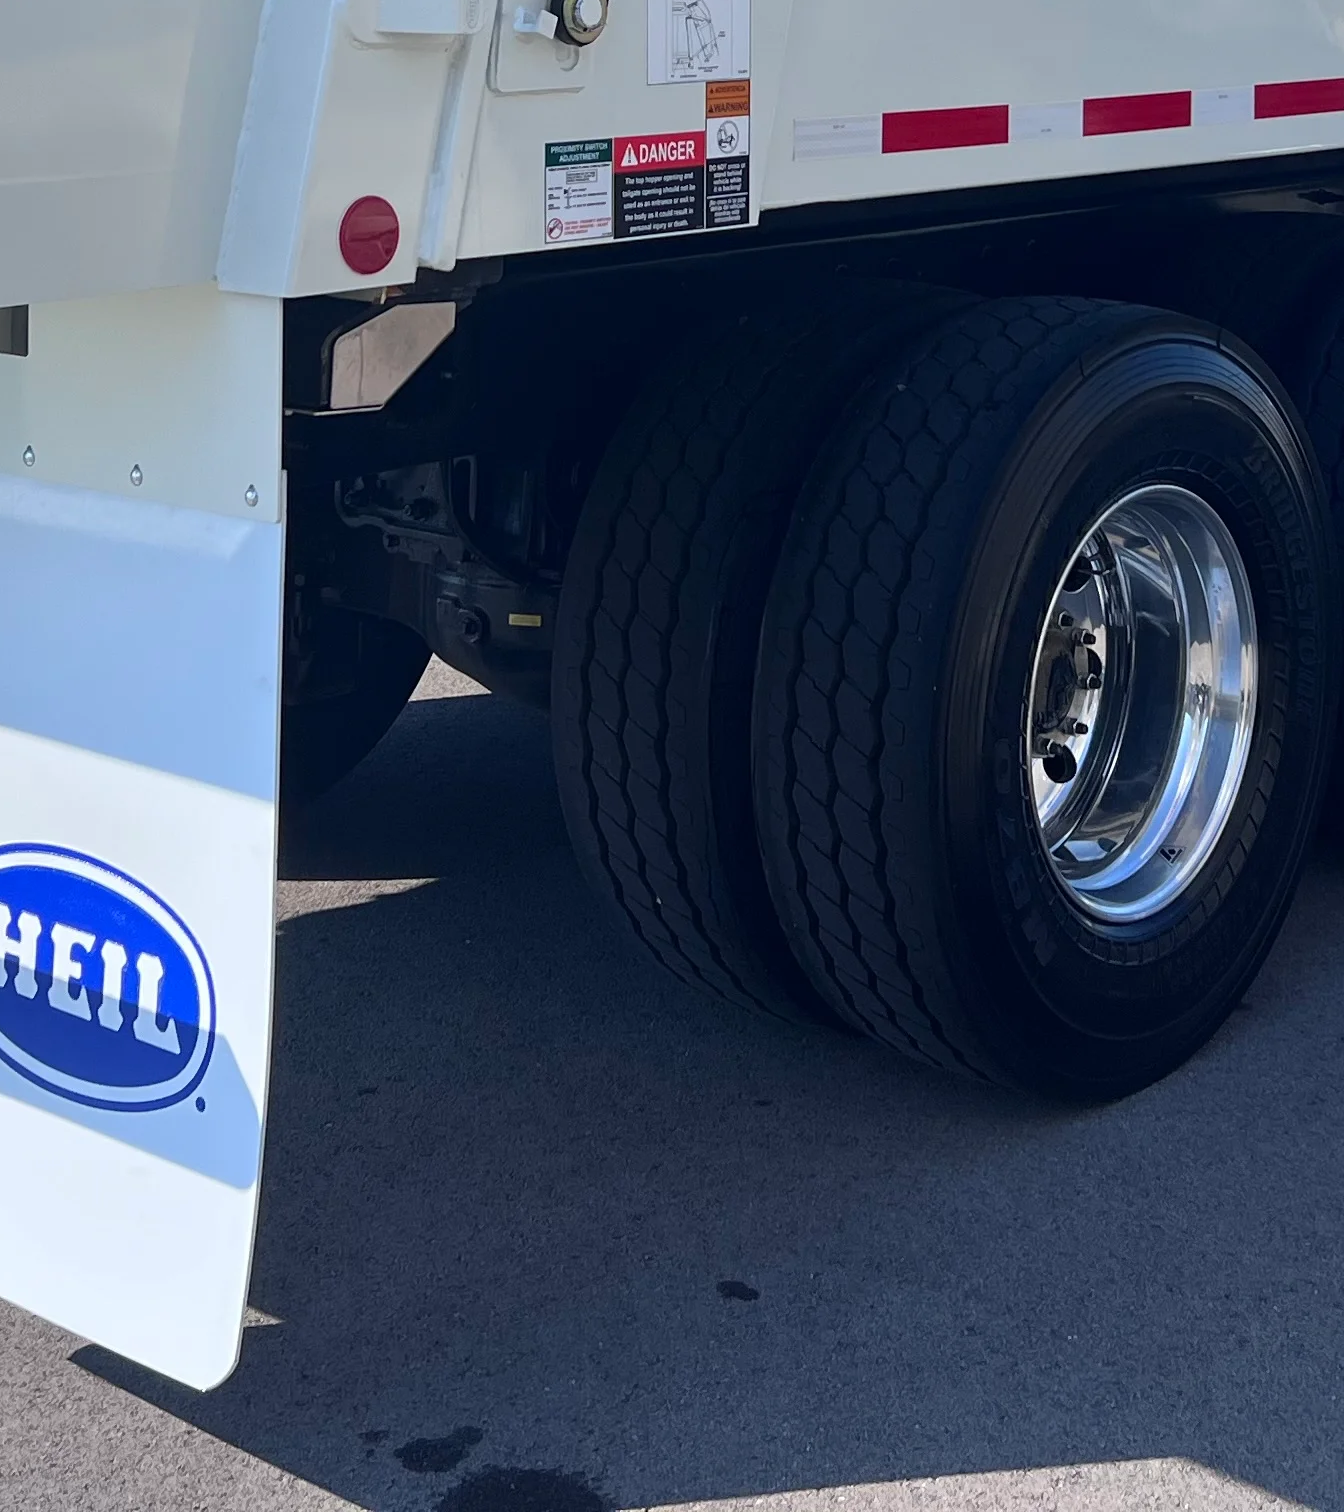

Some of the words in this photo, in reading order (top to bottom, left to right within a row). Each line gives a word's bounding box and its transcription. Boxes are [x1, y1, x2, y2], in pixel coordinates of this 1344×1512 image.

[713, 100, 748, 113] WARNING
[640, 140, 695, 164] DANGER
[709, 164, 716, 172] DO
[634, 213, 646, 221] body
[659, 209, 673, 217] could
